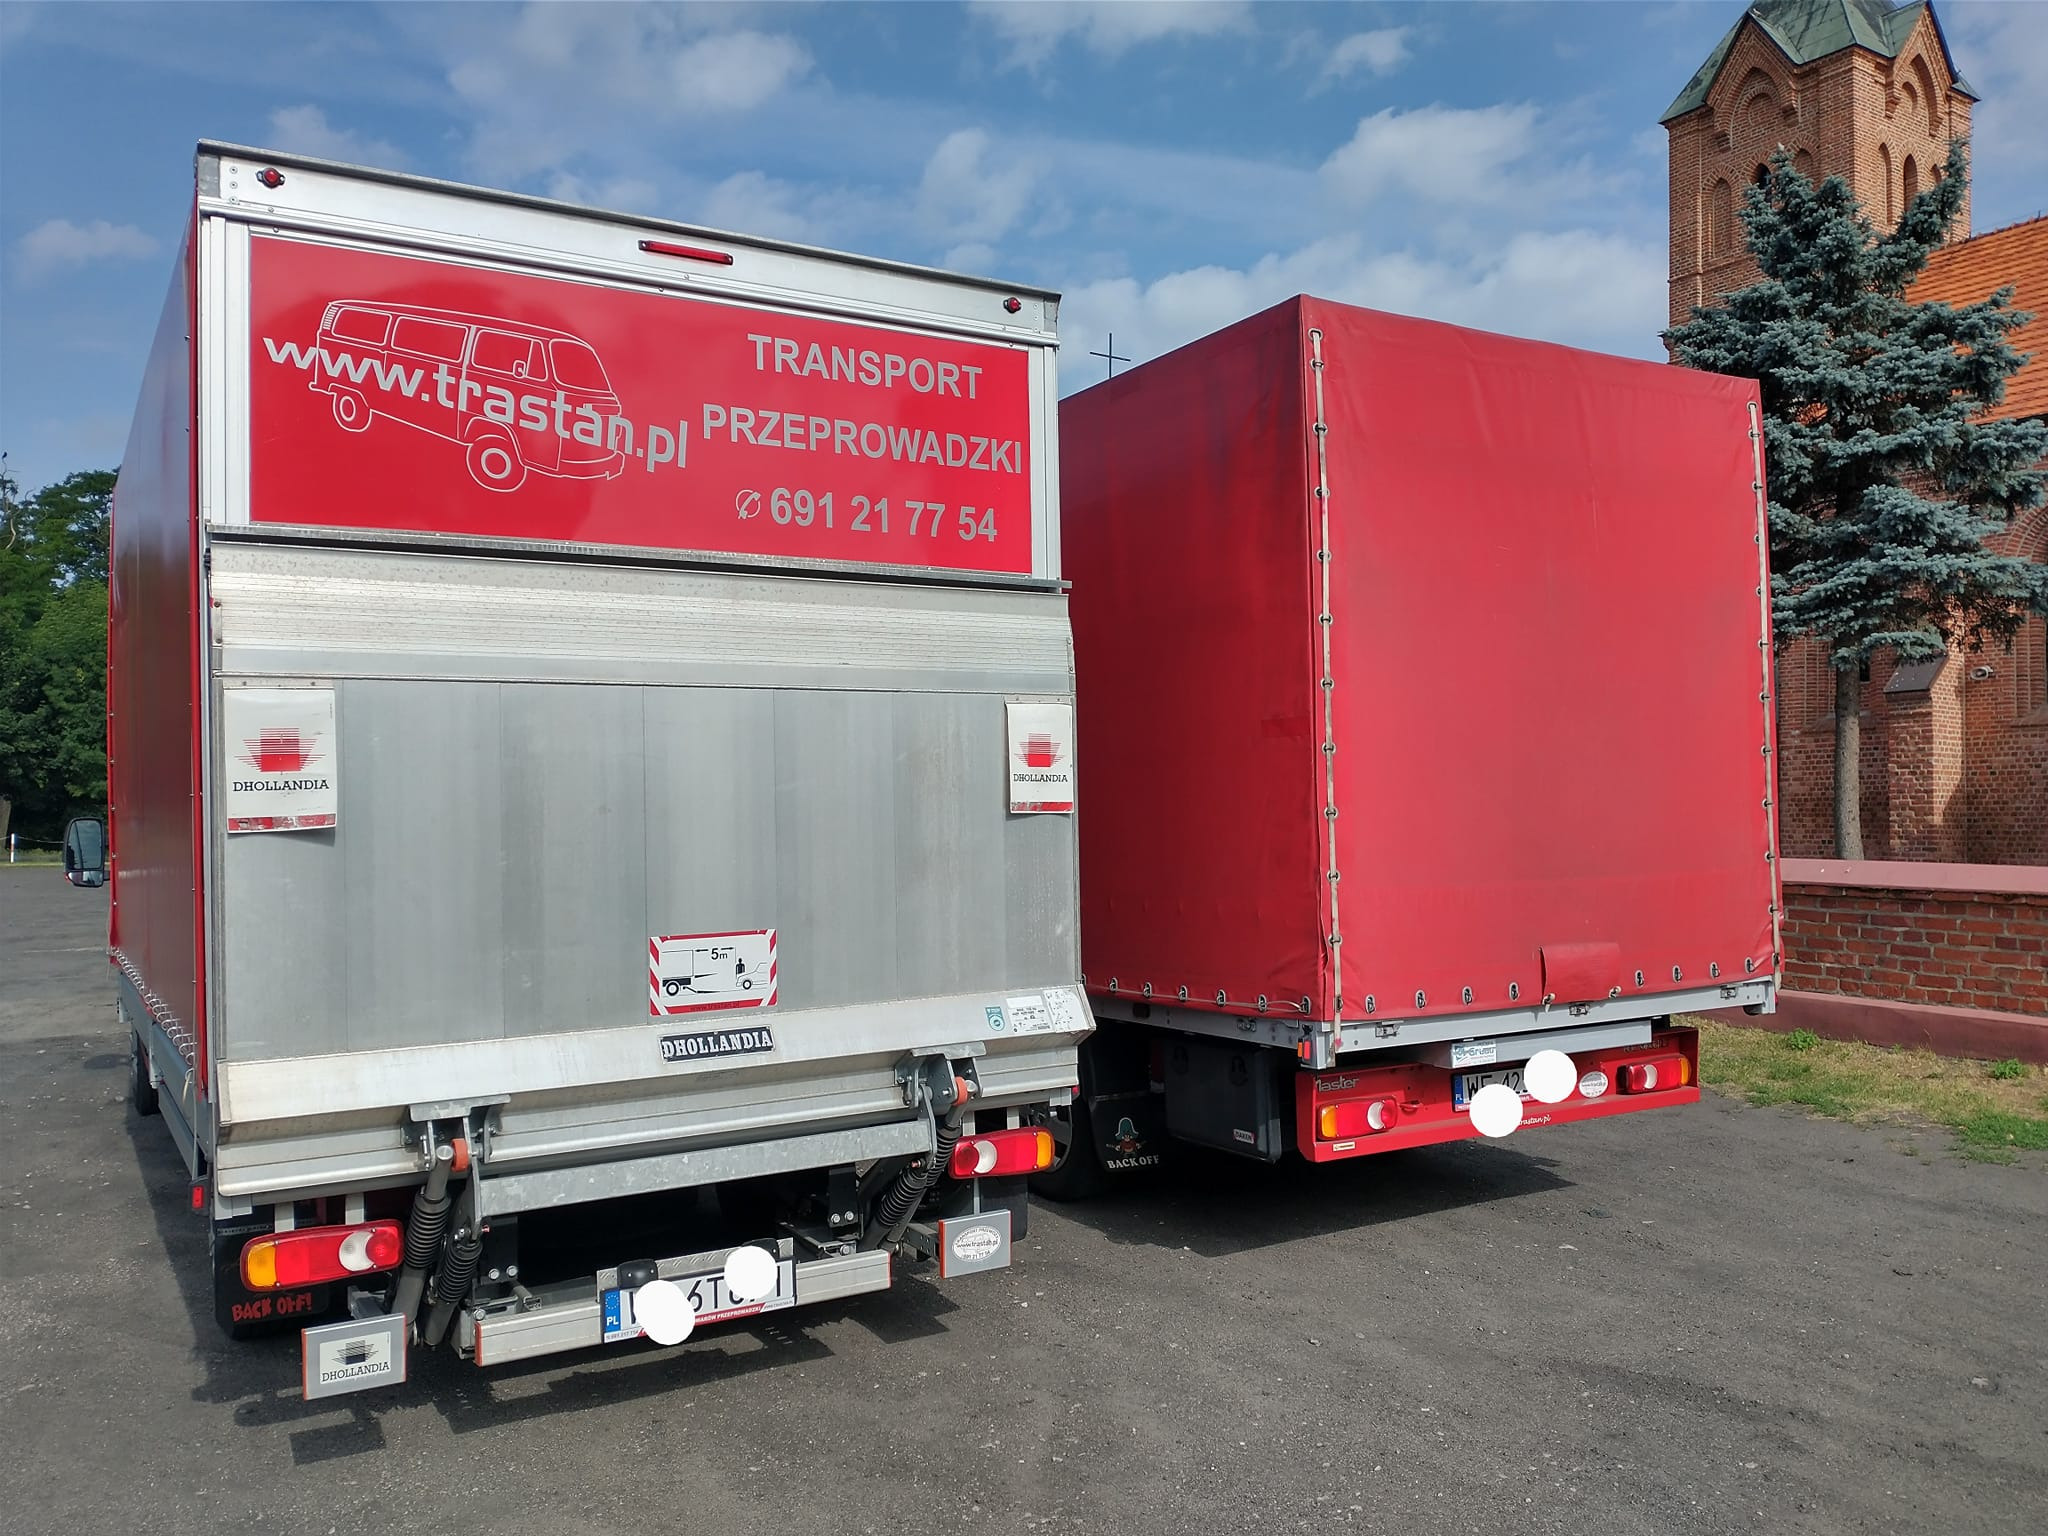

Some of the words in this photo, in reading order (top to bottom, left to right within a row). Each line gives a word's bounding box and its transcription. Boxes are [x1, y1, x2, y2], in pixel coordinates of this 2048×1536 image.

[747, 333, 982, 399] TRANSPORT
[263, 337, 687, 472] www.trastan.pl
[703, 403, 1022, 473] PRZEPROWADZKI
[770, 488, 833, 528] 691
[850, 496, 888, 533] 21
[905, 501, 945, 537] 77
[958, 507, 998, 542] 54
[233, 779, 329, 792] DHOLLANDIA
[1013, 773, 1068, 783] DHOLLANDIA
[662, 1030, 773, 1059] DHOLLANDIA
[1107, 1157, 1139, 1169] BACK
[1139, 1154, 1160, 1166] OFF
[231, 1298, 273, 1322] BACK
[276, 1293, 313, 1315] OFF!
[606, 1316, 619, 1326] PL
[322, 1361, 390, 1382] DHOLLANDIA
